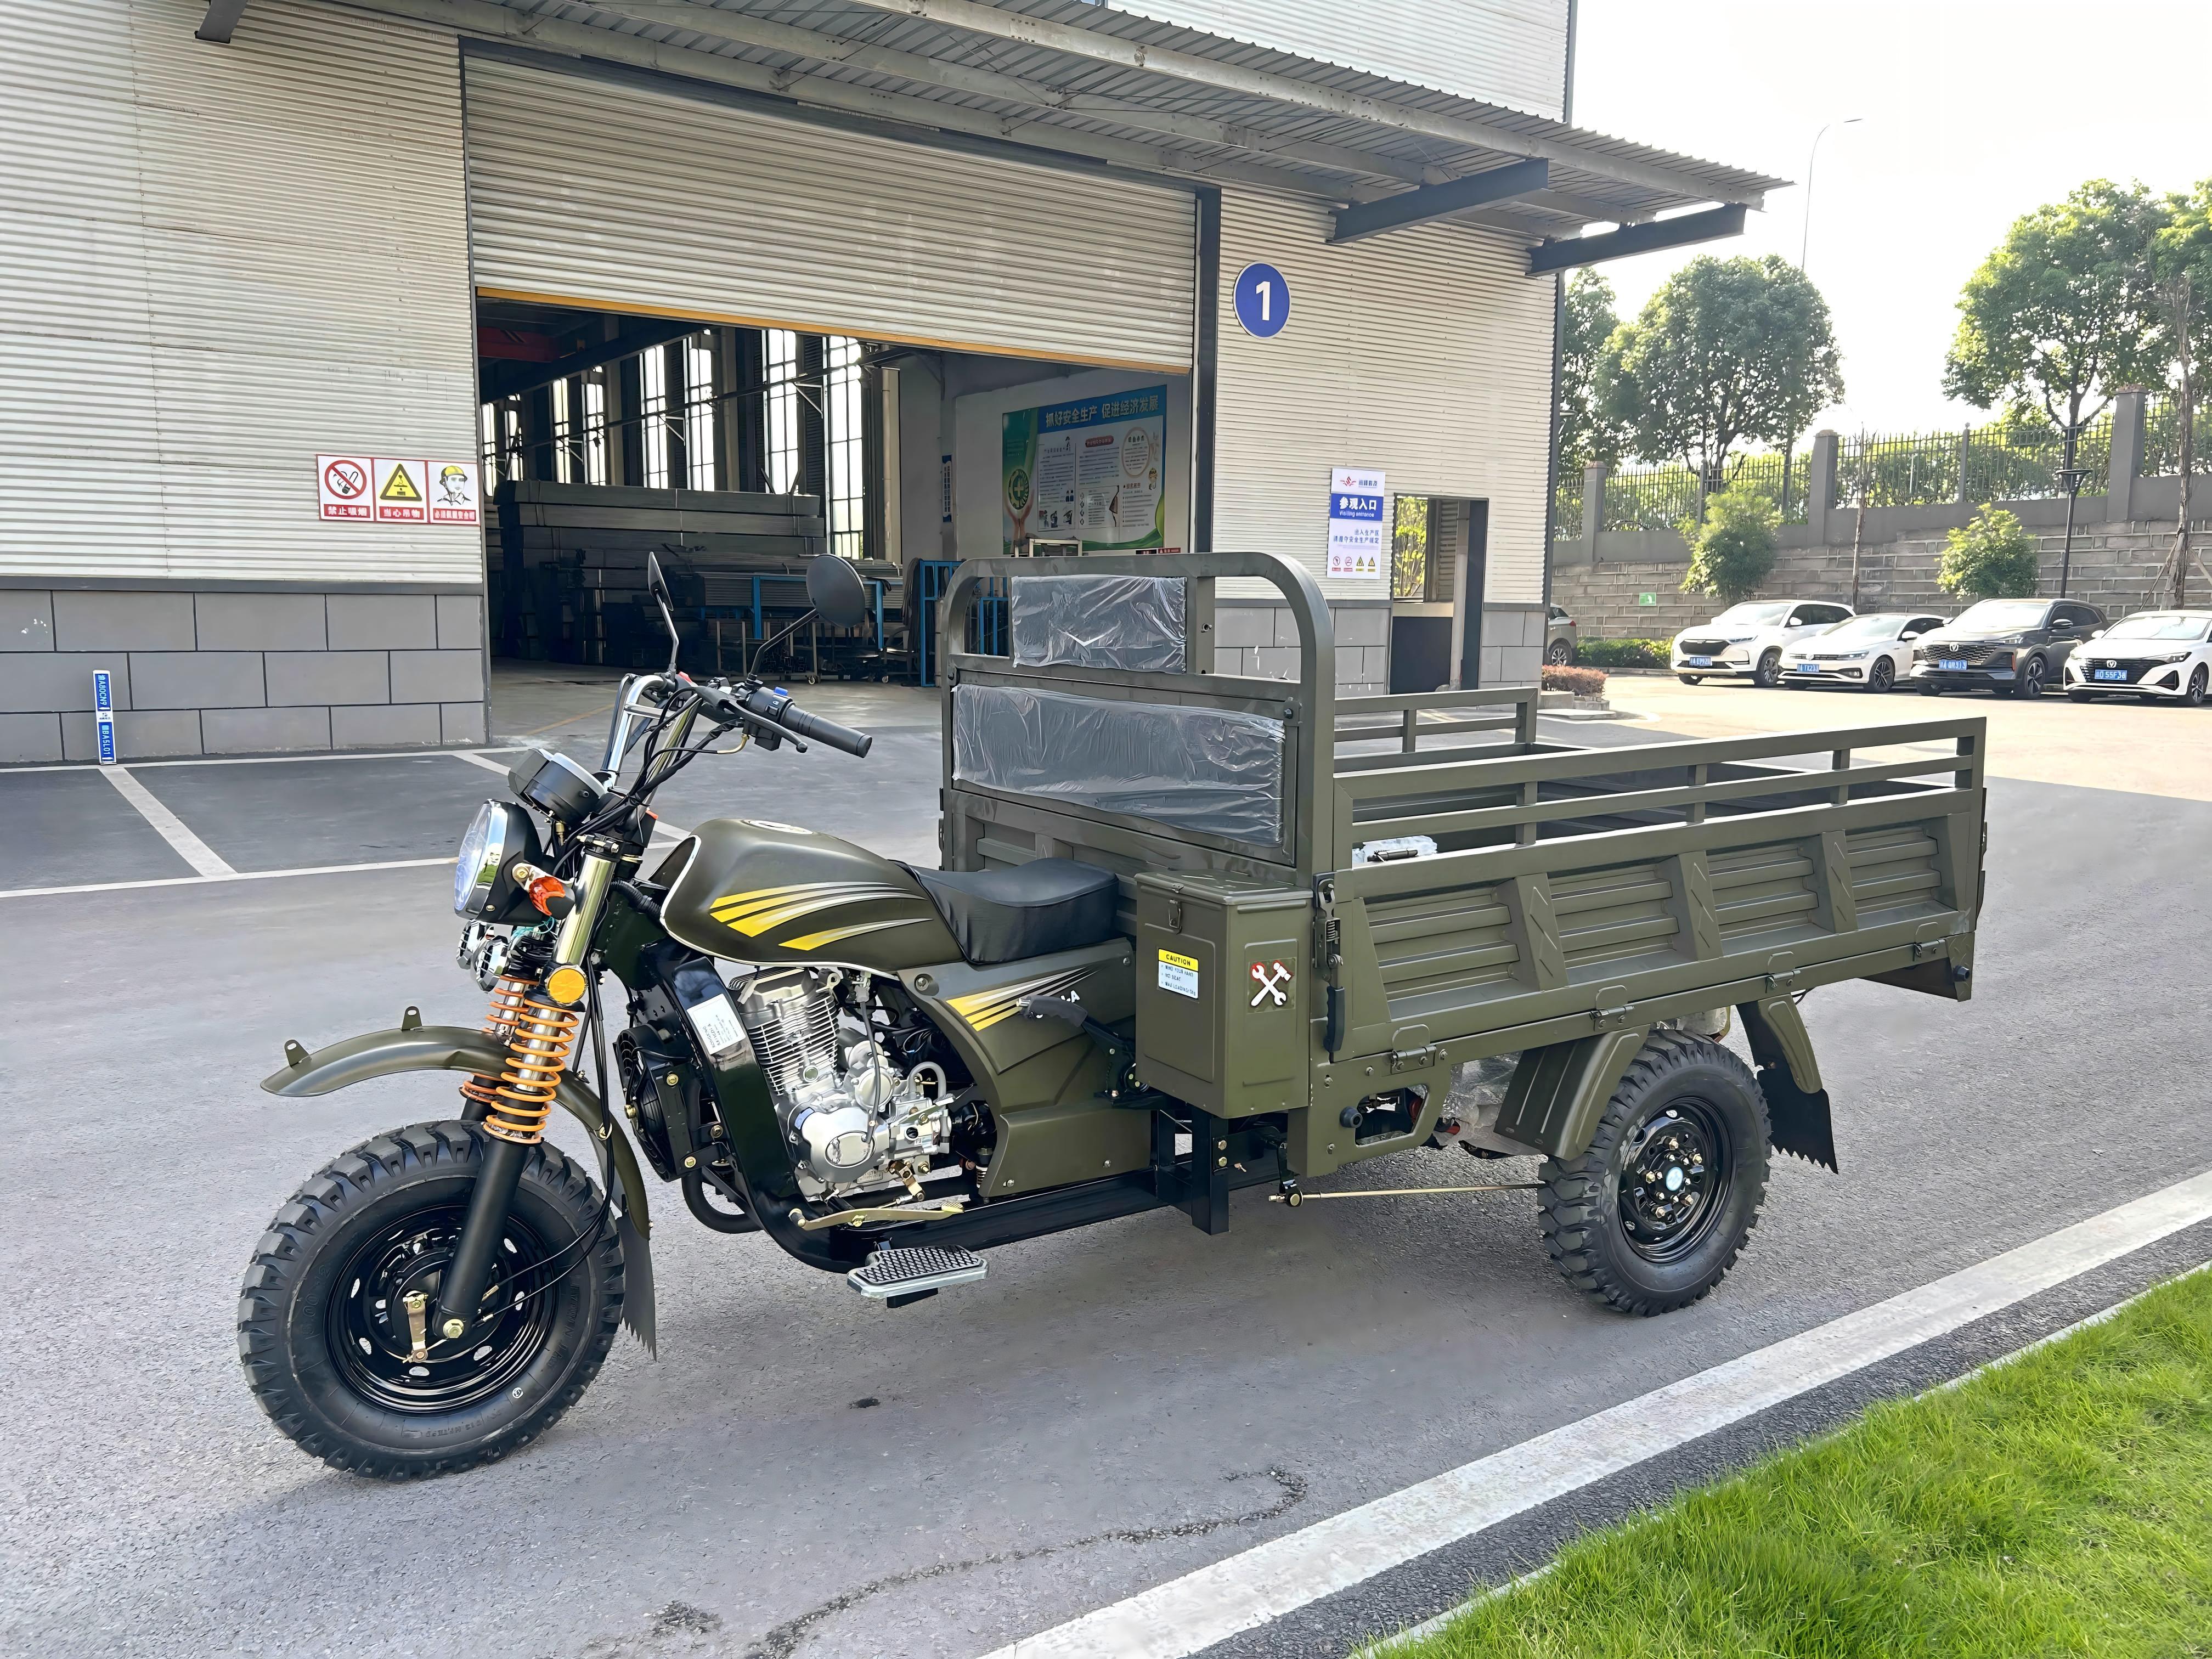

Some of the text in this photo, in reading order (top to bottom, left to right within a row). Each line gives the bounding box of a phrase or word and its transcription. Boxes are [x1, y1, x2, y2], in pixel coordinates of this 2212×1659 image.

[1256, 281, 1271, 321] 1
[1046, 395, 1159, 428] 抓好安全生产 促进经济发展
[328, 506, 367, 516] 禁止吸烟
[1339, 496, 1377, 511] 参观入口
[383, 506, 421, 518] 当心吊物
[101, 725, 111, 755] BA5L01
[1166, 954, 1190, 966] CAUTION
